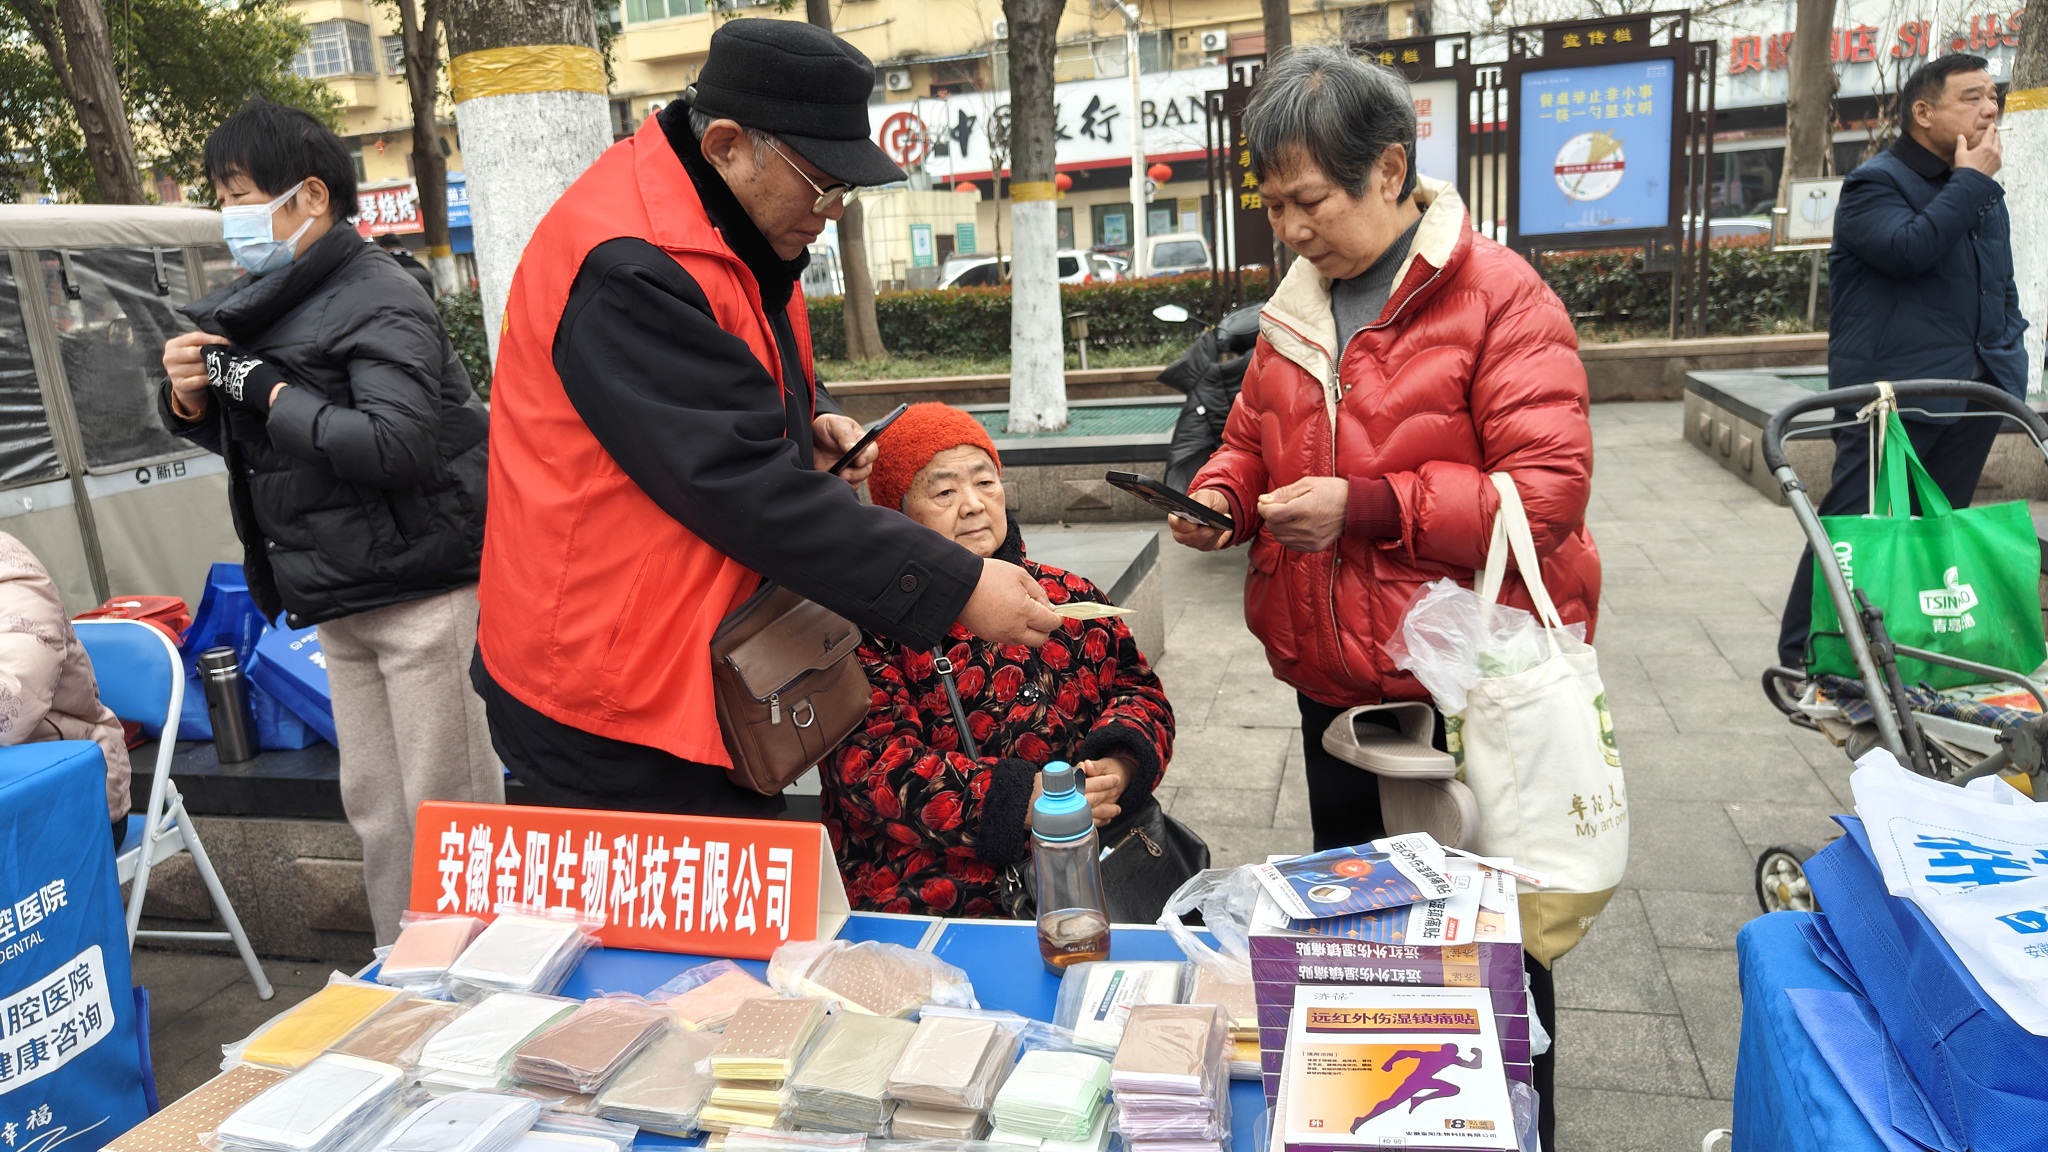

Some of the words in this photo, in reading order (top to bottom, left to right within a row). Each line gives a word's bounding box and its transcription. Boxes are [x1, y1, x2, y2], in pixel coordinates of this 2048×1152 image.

[1562, 27, 1633, 49] 宣传栏
[1540, 84, 1653, 108] 餐桌举止非小事
[1539, 101, 1653, 123] 一筷一勺显文明
[156, 461, 187, 480] 新日
[1576, 822, 1597, 838] My
[1601, 817, 1614, 832] art
[436, 821, 793, 941] 安徽金阳生物科技有限公司
[1296, 941, 1420, 960] 远红外伤湿镇痛贴
[1298, 965, 1422, 984] 远红外伤湿镇痛贴
[1311, 1012, 1475, 1025] 远红外伤湿镇痛贴
[1, 1103, 53, 1147] 幸福
[1451, 1118, 1466, 1129] 8
